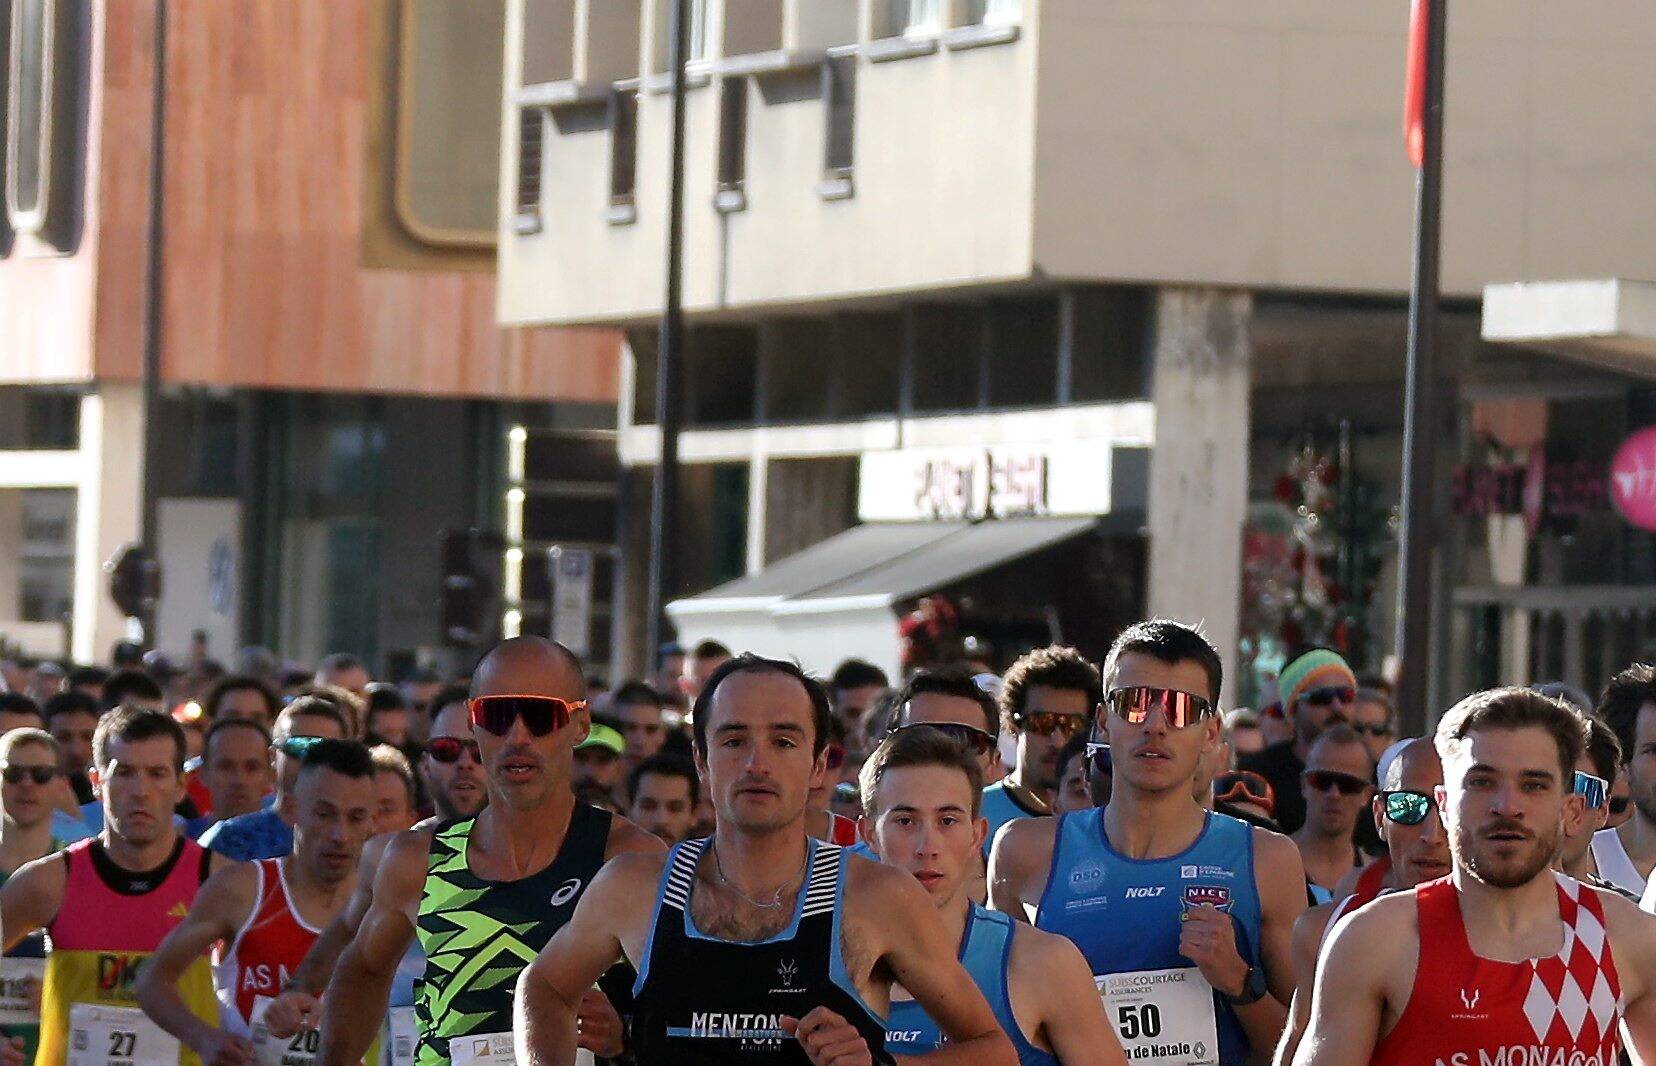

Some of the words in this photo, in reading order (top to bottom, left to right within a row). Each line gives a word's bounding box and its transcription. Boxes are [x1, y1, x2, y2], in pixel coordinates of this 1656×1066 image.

[1125, 886, 1166, 899] NOLT
[1188, 888, 1227, 899] NICE
[243, 963, 272, 990] AS
[690, 1011, 785, 1045] MENTON
[1118, 1003, 1161, 1040] 50
[109, 1030, 136, 1057] 27
[1134, 1045, 1149, 1059] de
[1151, 1042, 1190, 1058] Natale
